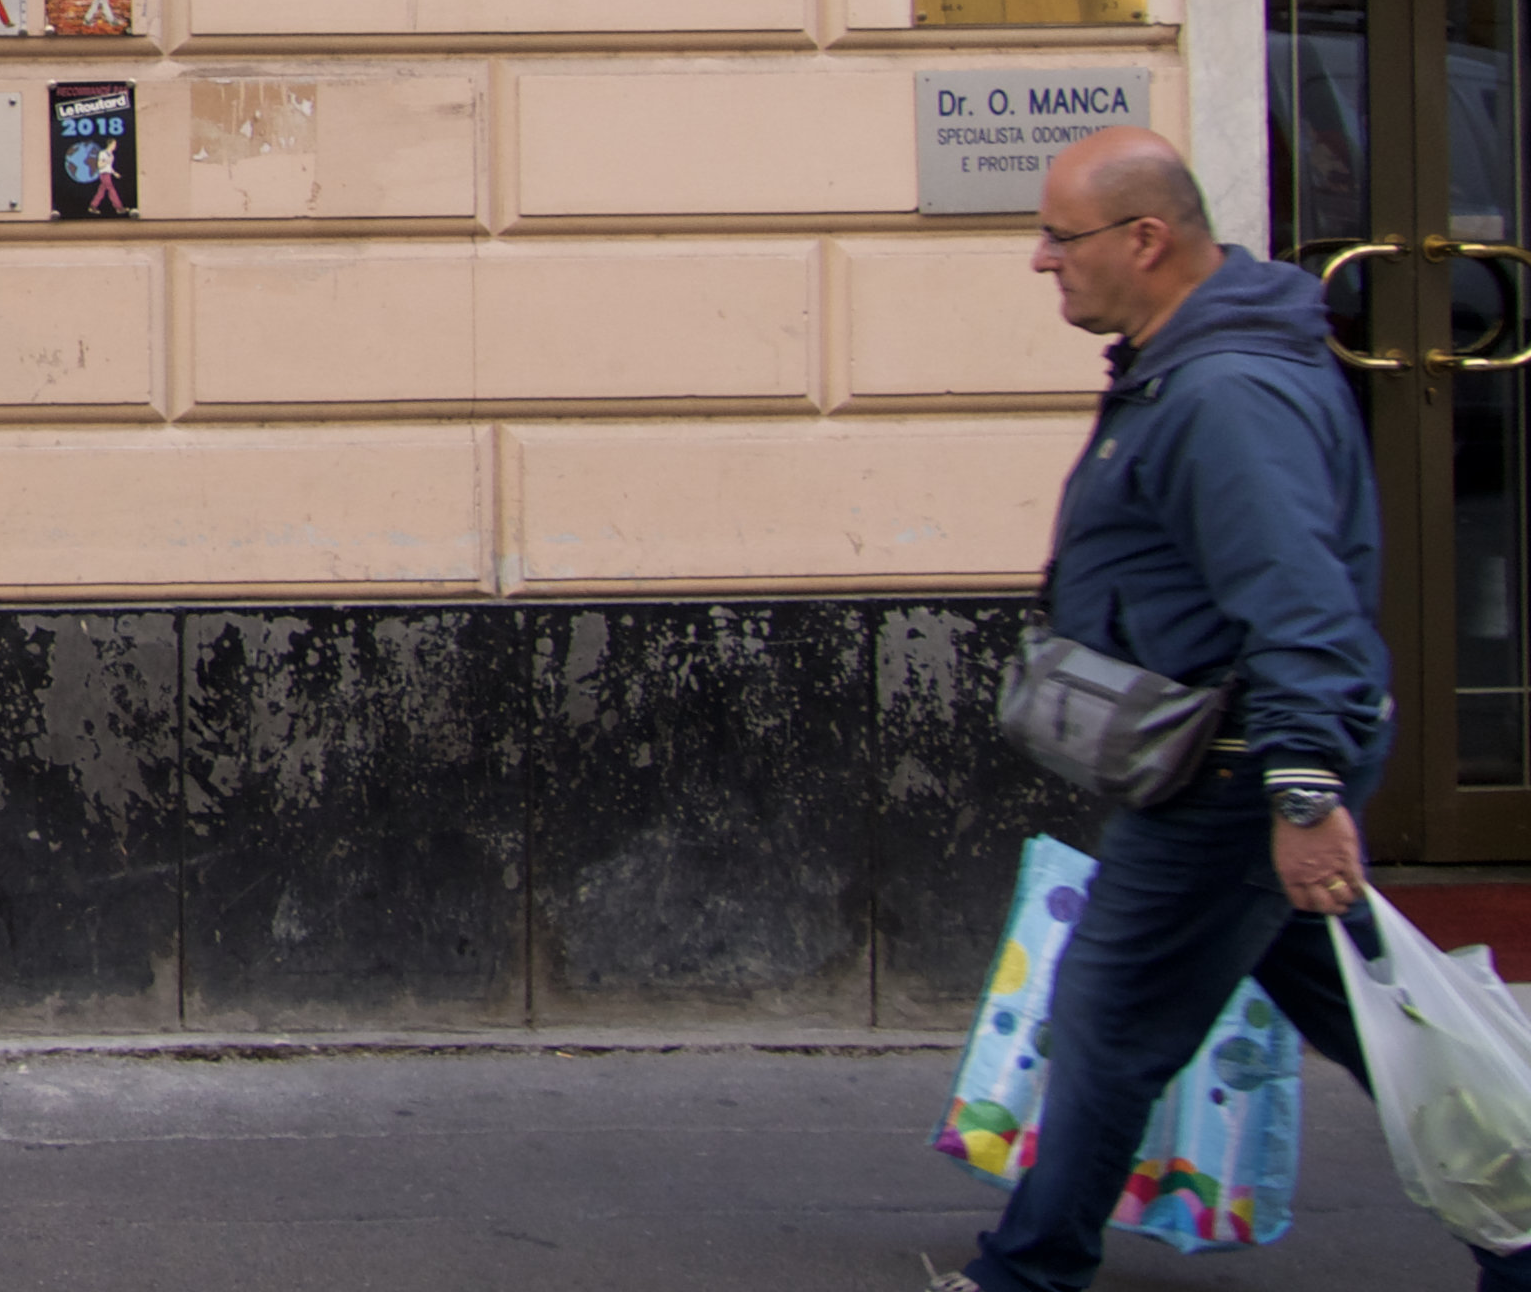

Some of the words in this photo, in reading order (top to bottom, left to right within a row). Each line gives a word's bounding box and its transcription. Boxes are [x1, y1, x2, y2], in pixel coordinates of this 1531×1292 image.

[59, 105, 74, 117] Le
[75, 95, 127, 114] Routard
[938, 89, 974, 116] Dr.
[988, 88, 1015, 116] O.
[1029, 87, 1130, 115] MANCA
[61, 117, 125, 136] 2018
[937, 127, 1024, 145] SPECIALISTA
[961, 156, 971, 173] E
[978, 155, 1040, 172] PROTESI
